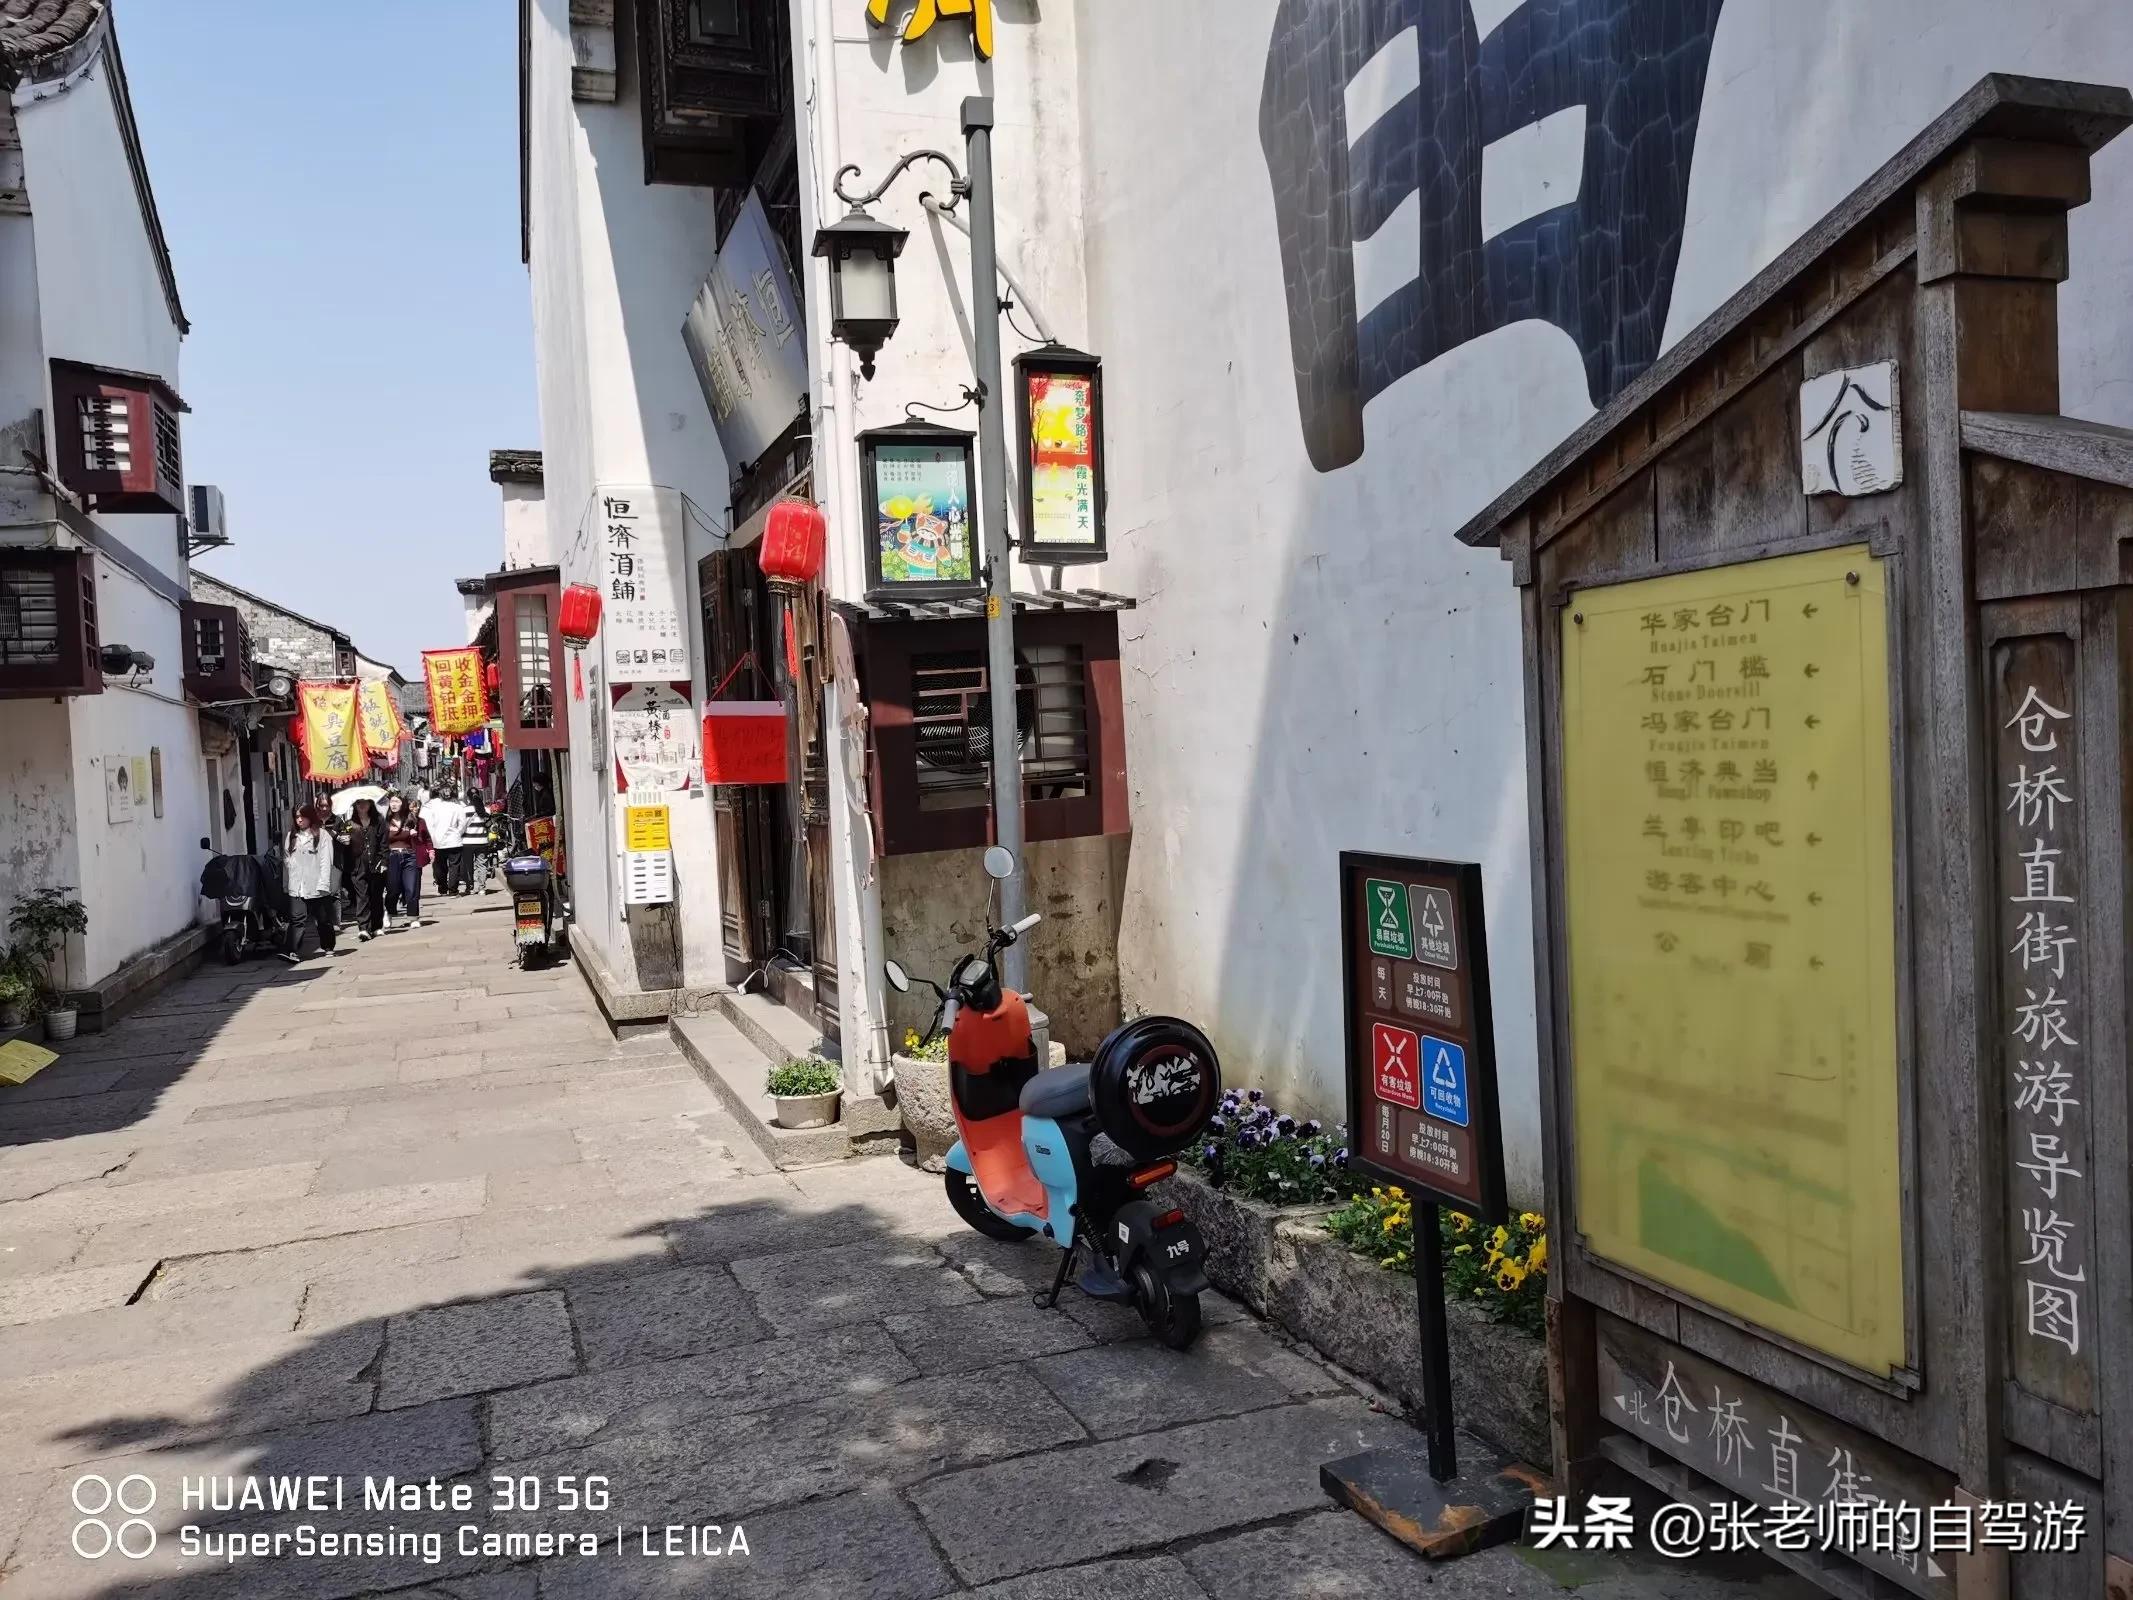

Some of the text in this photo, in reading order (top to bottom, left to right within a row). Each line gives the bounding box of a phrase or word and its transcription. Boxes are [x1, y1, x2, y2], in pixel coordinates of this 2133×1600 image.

[1640, 599, 1770, 636] 华家台门
[435, 657, 471, 673] 回收
[1641, 656, 1770, 686] 石门槛
[438, 673, 473, 689] 黄金
[442, 705, 478, 721] 抵押
[1640, 707, 1770, 734] 冯家台门
[1377, 966, 1387, 1000] 每天
[2004, 685, 2085, 1355] 仓桥直街旅游导览图
[1381, 1074, 1412, 1093] 有害垃圾
[1430, 1086, 1461, 1108] 可回收物
[1166, 1239, 1189, 1259] 九号
[1628, 1393, 1650, 1426] 北
